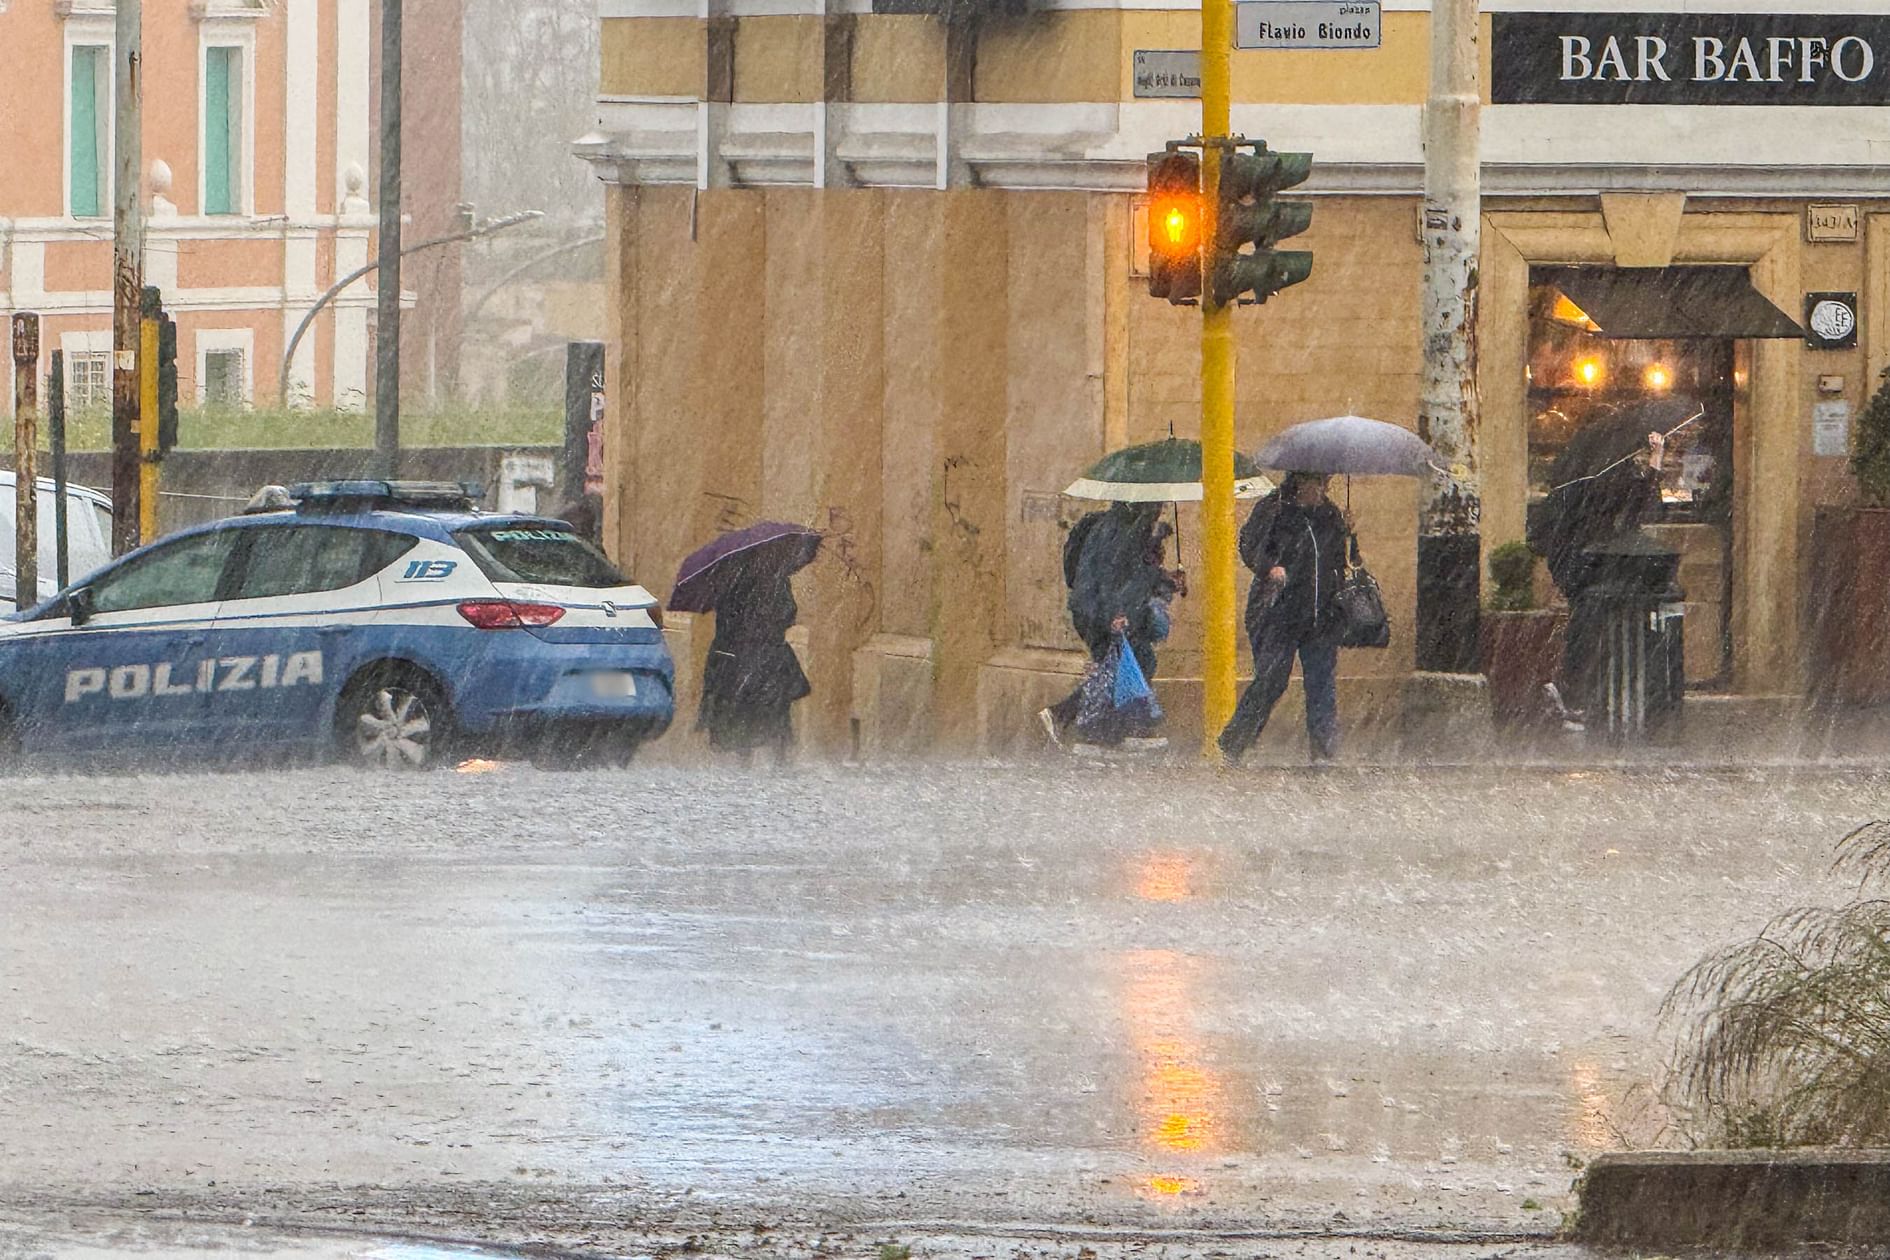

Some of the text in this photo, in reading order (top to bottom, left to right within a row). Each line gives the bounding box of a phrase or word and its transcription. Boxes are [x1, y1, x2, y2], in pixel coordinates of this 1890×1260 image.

[1259, 22, 1371, 40] Flavio Biondo
[1558, 35, 1874, 83] BAR BAFFO
[403, 560, 458, 579] 113
[64, 651, 323, 704] POLIZIA
